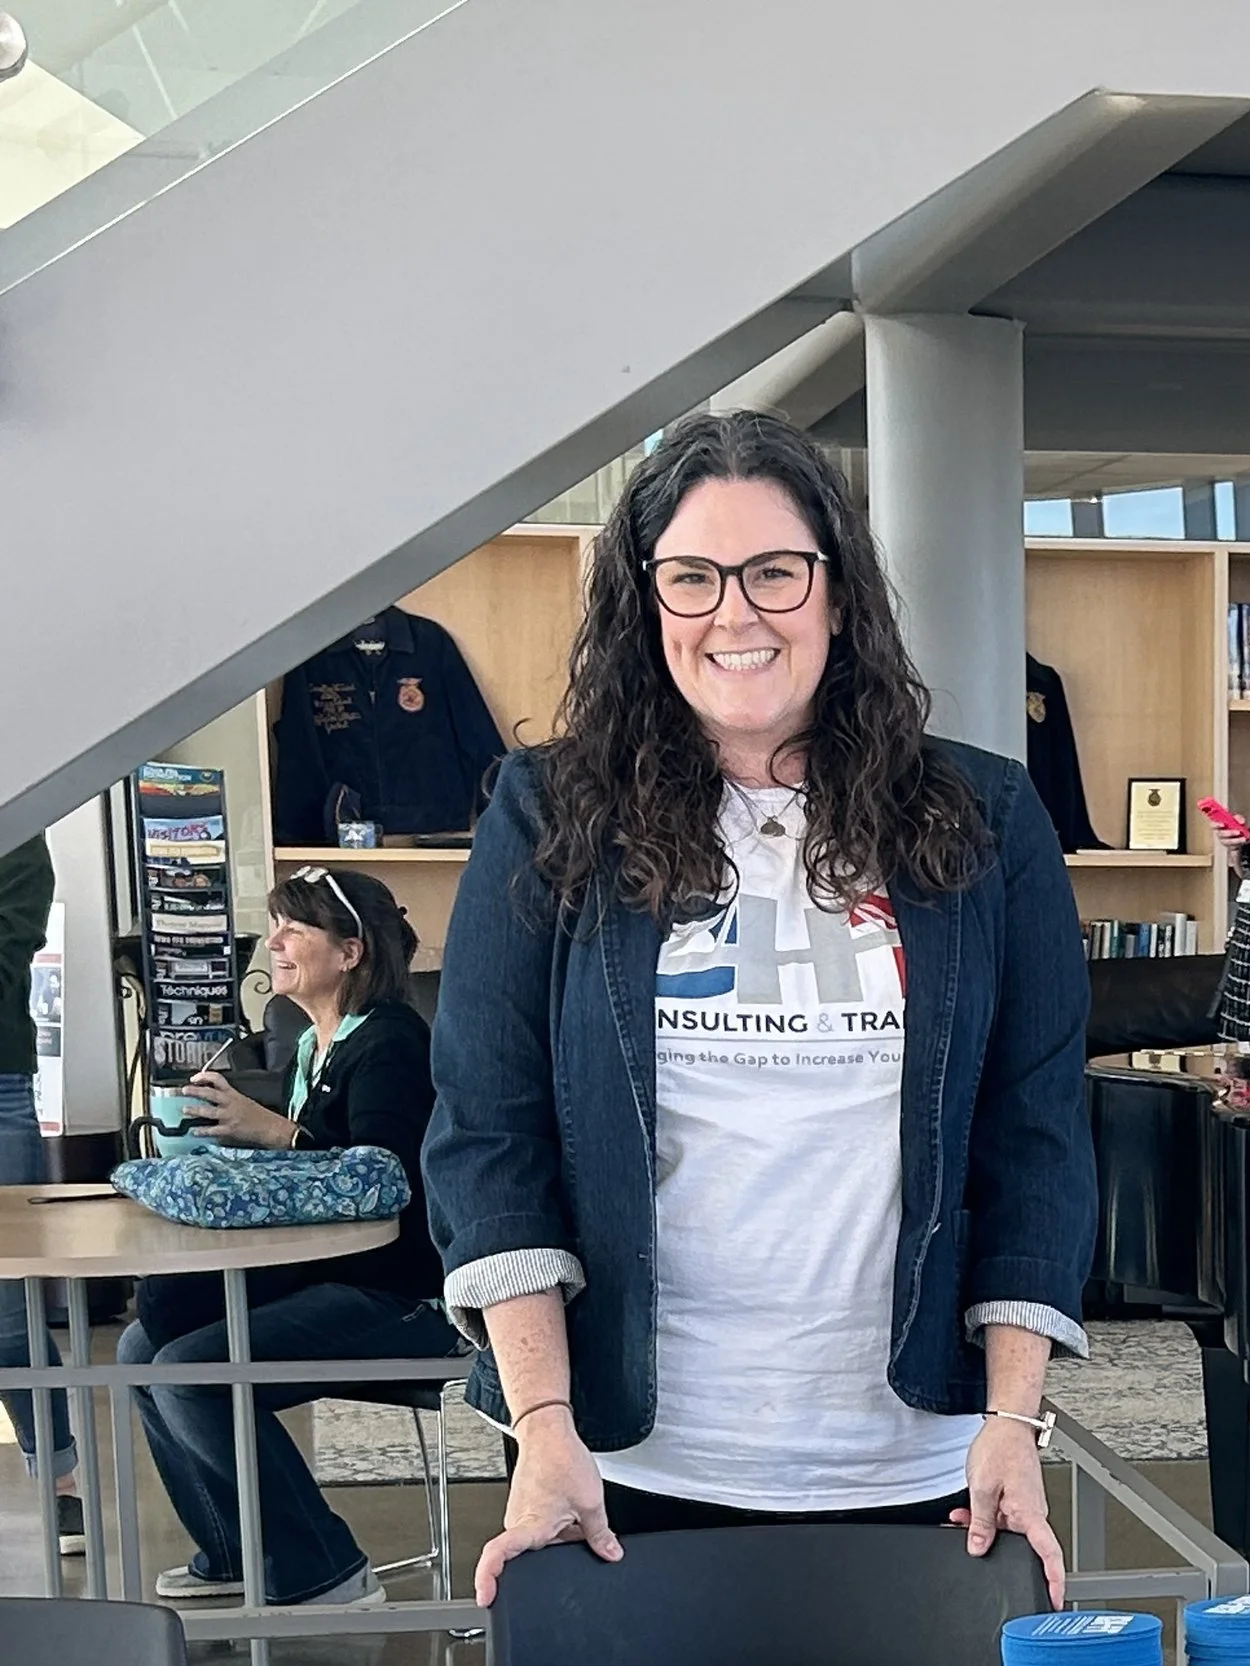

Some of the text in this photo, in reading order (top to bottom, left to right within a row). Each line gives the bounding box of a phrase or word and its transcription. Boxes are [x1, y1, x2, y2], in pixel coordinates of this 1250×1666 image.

[657, 1009, 809, 1034] NSULTING
[816, 1012, 835, 1033] &
[699, 1050, 730, 1064] the
[733, 1052, 769, 1068] Gap
[773, 1053, 791, 1066] to
[795, 1052, 864, 1065] Increase
